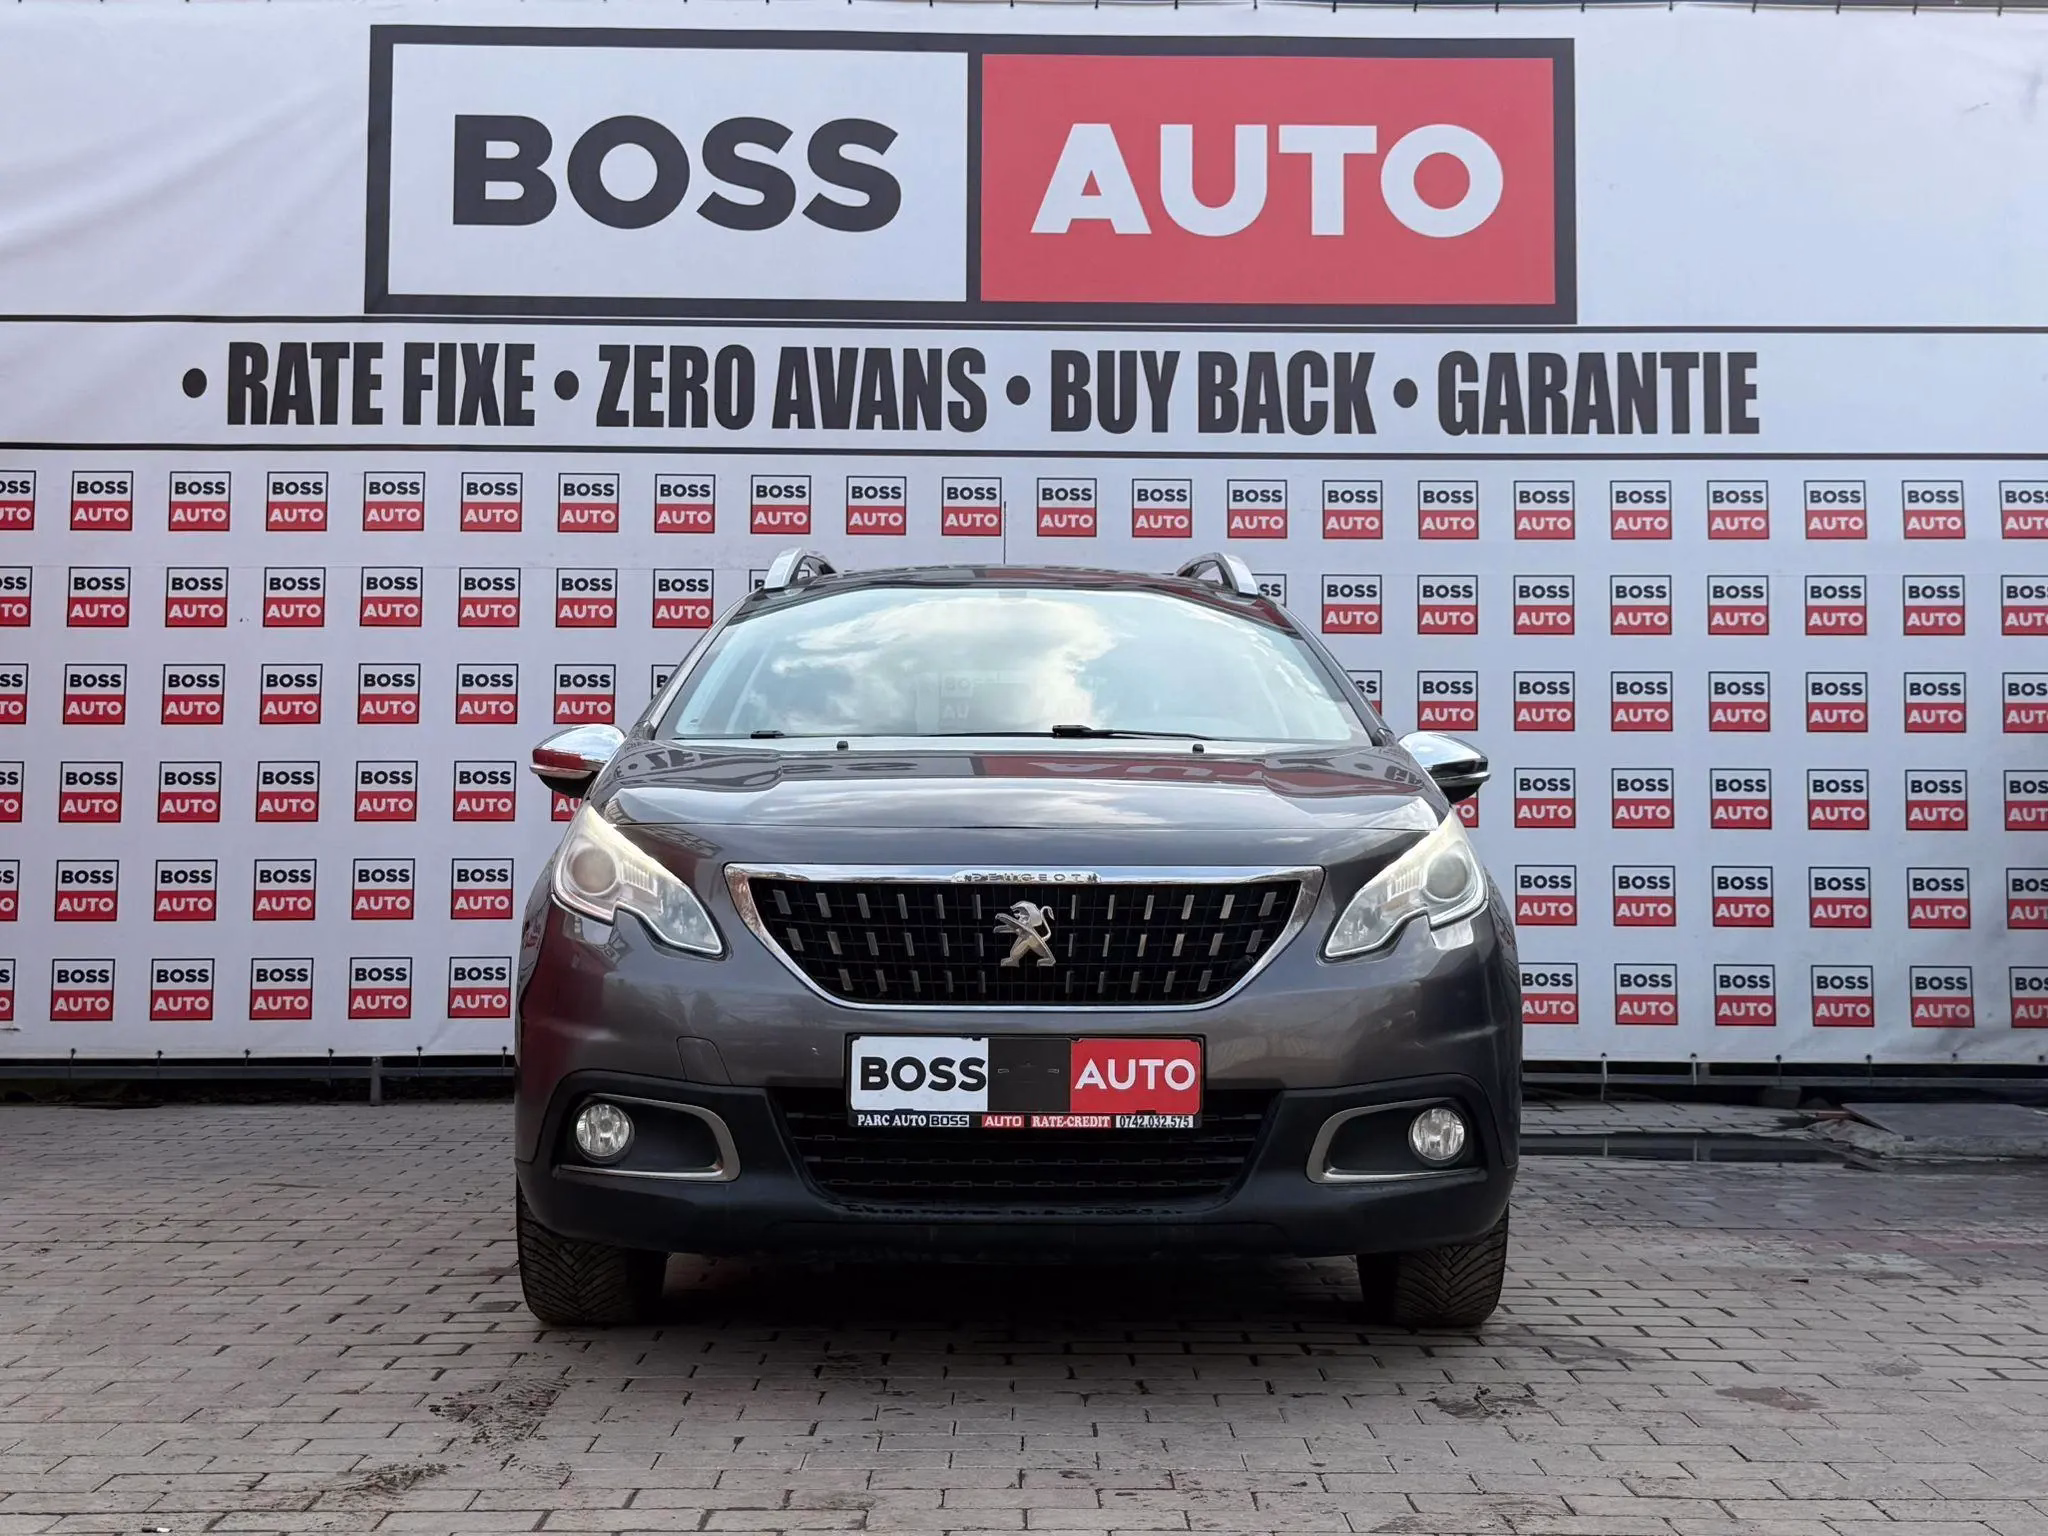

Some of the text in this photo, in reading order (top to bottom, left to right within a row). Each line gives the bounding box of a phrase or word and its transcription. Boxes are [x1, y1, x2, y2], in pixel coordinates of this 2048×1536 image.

[453, 114, 1504, 238] BOSS AUTO
[227, 342, 1760, 436] RATE FIXE ZERO AVANS BUY BACK GARANTIE
[76, 481, 128, 494] BOSS
[174, 481, 226, 495] BOSS
[369, 481, 420, 495] BOSS
[564, 483, 614, 497] BOSS
[660, 484, 711, 498] BOSS
[756, 485, 806, 498] BOSS
[852, 486, 902, 500] BOSS
[947, 486, 997, 500] BOSS
[1042, 488, 1092, 501] BOSS
[1137, 488, 1187, 502] BOSS
[1232, 489, 1282, 503] BOSS
[1328, 490, 1378, 504] BOSS
[1423, 490, 1474, 504] BOSS
[1519, 490, 1570, 504] BOSS
[1712, 490, 1764, 504] BOSS
[1908, 490, 1959, 504] BOSS
[74, 508, 129, 522] AUTO
[172, 508, 227, 522] AUTO
[366, 508, 421, 522] AUTO
[561, 510, 616, 524] AUTO
[657, 510, 712, 524] AUTO
[753, 511, 808, 525] AUTO
[849, 512, 903, 526] AUTO
[944, 513, 998, 527] AUTO
[1040, 514, 1094, 528] AUTO
[1135, 515, 1189, 529] AUTO
[1230, 516, 1284, 530] AUTO
[1326, 516, 1380, 530] AUTO
[1421, 516, 1476, 530] AUTO
[1517, 517, 1572, 531] AUTO
[1711, 517, 1766, 531] AUTO
[1907, 516, 1962, 530] AUTO
[74, 577, 126, 590] BOSS
[172, 577, 223, 591] BOSS
[366, 576, 418, 590] BOSS
[464, 577, 516, 591] BOSS
[562, 578, 612, 592] BOSS
[658, 578, 709, 592] BOSS
[1327, 584, 1377, 598] BOSS
[1422, 584, 1473, 598] BOSS
[1519, 585, 1570, 599] BOSS
[1615, 585, 1667, 599] BOSS
[1810, 585, 1862, 599] BOSS
[1908, 585, 1960, 599] BOSS
[70, 604, 126, 618] AUTO
[168, 604, 224, 618] AUTO
[363, 604, 419, 618] AUTO
[461, 604, 516, 618] AUTO
[559, 604, 613, 618] AUTO
[656, 605, 710, 619] AUTO
[1325, 611, 1379, 625] AUTO
[1420, 612, 1475, 626] AUTO
[1517, 612, 1571, 626] AUTO
[1613, 612, 1669, 626] AUTO
[1808, 612, 1864, 626] AUTO
[1906, 612, 1962, 626] AUTO
[70, 674, 122, 688] BOSS
[168, 674, 220, 688] BOSS
[364, 674, 416, 687] BOSS
[462, 674, 514, 688] BOSS
[560, 674, 611, 688] BOSS
[1422, 681, 1473, 694] BOSS
[1519, 681, 1570, 695] BOSS
[1616, 681, 1668, 695] BOSS
[1714, 682, 1765, 696] BOSS
[1811, 682, 1863, 696] BOSS
[1910, 682, 1961, 696] BOSS
[66, 701, 122, 715] AUTO
[165, 701, 220, 715] AUTO
[361, 700, 416, 715] AUTO
[459, 701, 514, 715] AUTO
[556, 701, 612, 715] AUTO
[1420, 708, 1475, 722] AUTO
[1517, 708, 1572, 722] AUTO
[1614, 708, 1670, 722] AUTO
[1712, 708, 1767, 723] AUTO
[1809, 709, 1865, 723] AUTO
[1908, 709, 1963, 724] AUTO
[65, 772, 118, 786] BOSS
[164, 772, 216, 786] BOSS
[360, 770, 413, 785] BOSS
[459, 770, 512, 785] BOSS
[1520, 778, 1571, 792] BOSS
[1617, 778, 1669, 792] BOSS
[1716, 778, 1766, 792] BOSS
[1812, 779, 1864, 793] BOSS
[1911, 780, 1962, 794] BOSS
[62, 799, 118, 813] AUTO
[161, 799, 217, 813] AUTO
[357, 798, 414, 812] AUTO
[456, 798, 512, 812] AUTO
[1518, 805, 1572, 819] AUTO
[1615, 805, 1671, 820] AUTO
[1714, 806, 1768, 820] AUTO
[1811, 806, 1866, 821] AUTO
[1909, 807, 1965, 821] AUTO
[61, 870, 114, 884] BOSS
[160, 870, 212, 884] BOSS
[358, 868, 410, 883] BOSS
[457, 868, 508, 882] BOSS
[1520, 875, 1572, 889] BOSS
[1618, 876, 1670, 890] BOSS
[1717, 876, 1768, 890] BOSS
[1814, 877, 1866, 891] BOSS
[1912, 878, 1964, 892] BOSS
[58, 898, 114, 912] AUTO
[157, 897, 213, 912] AUTO
[355, 896, 411, 910] AUTO
[454, 896, 510, 910] AUTO
[1519, 902, 1574, 916] AUTO
[1616, 903, 1672, 917] AUTO
[1715, 903, 1770, 918] AUTO
[1813, 904, 1868, 919] AUTO
[1911, 905, 1967, 920] AUTO
[57, 969, 110, 984] BOSS
[156, 968, 209, 983] BOSS
[256, 968, 308, 982] BOSS
[355, 967, 407, 982] BOSS
[454, 967, 506, 981] BOSS
[1620, 974, 1672, 988] BOSS
[1719, 974, 1770, 989] BOSS
[1816, 976, 1868, 990] BOSS
[1914, 976, 1968, 990] BOSS
[54, 997, 110, 1012] AUTO
[153, 996, 210, 1011] AUTO
[252, 996, 308, 1010] AUTO
[352, 995, 408, 1010] AUTO
[451, 994, 507, 1009] AUTO
[1618, 1001, 1675, 1016] AUTO
[1718, 1002, 1773, 1017] AUTO
[1816, 1003, 1871, 1018] AUTO
[1914, 1004, 1970, 1018] AUTO
[860, 1056, 1196, 1091] BOSS AUTO
[857, 1114, 890, 1126] PARC
[892, 1114, 927, 1126] AUTO
[931, 1115, 968, 1126] BOSS
[984, 1115, 1022, 1127] AUTO
[1032, 1115, 1111, 1127] RATE-CREDIT
